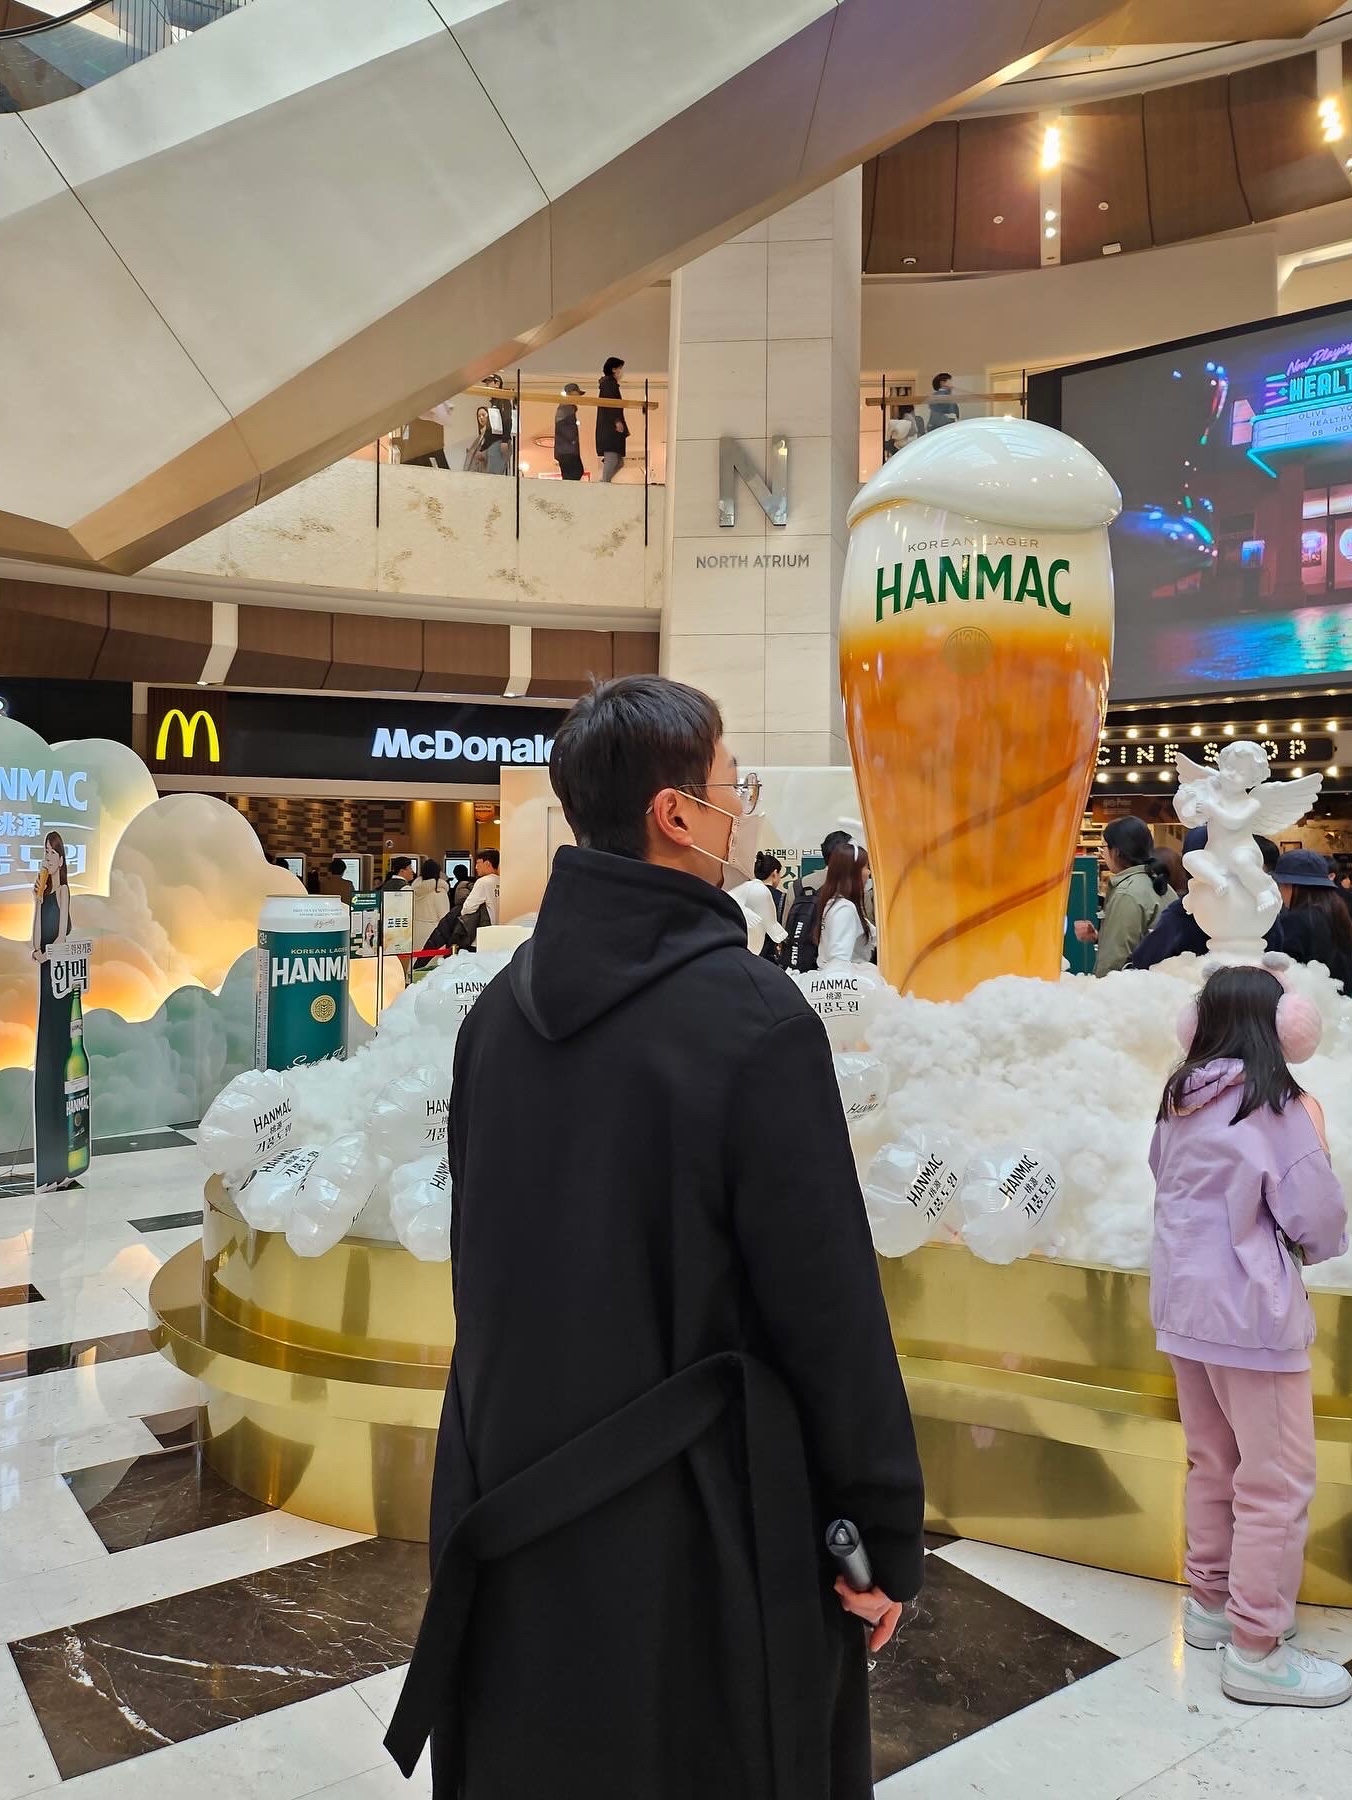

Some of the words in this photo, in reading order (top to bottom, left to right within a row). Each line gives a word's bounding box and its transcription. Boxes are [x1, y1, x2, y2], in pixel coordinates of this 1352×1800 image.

[1286, 357, 1312, 376] Now
[719, 436, 788, 528] N
[696, 555, 748, 569] NORTH
[753, 554, 809, 568] ATRIUM
[908, 537, 975, 553] KOREAN
[984, 537, 1039, 549] LAGER
[876, 554, 1071, 623] HANMAC
[1096, 743, 1179, 765] CINE
[1203, 739, 1307, 762] SOP
[53, 959, 87, 994] 한맥
[811, 978, 858, 993] HANMAC
[253, 1097, 292, 1134] HANMAC
[906, 1153, 944, 1207] HANMAC
[999, 1154, 1039, 1201] HANMAC
